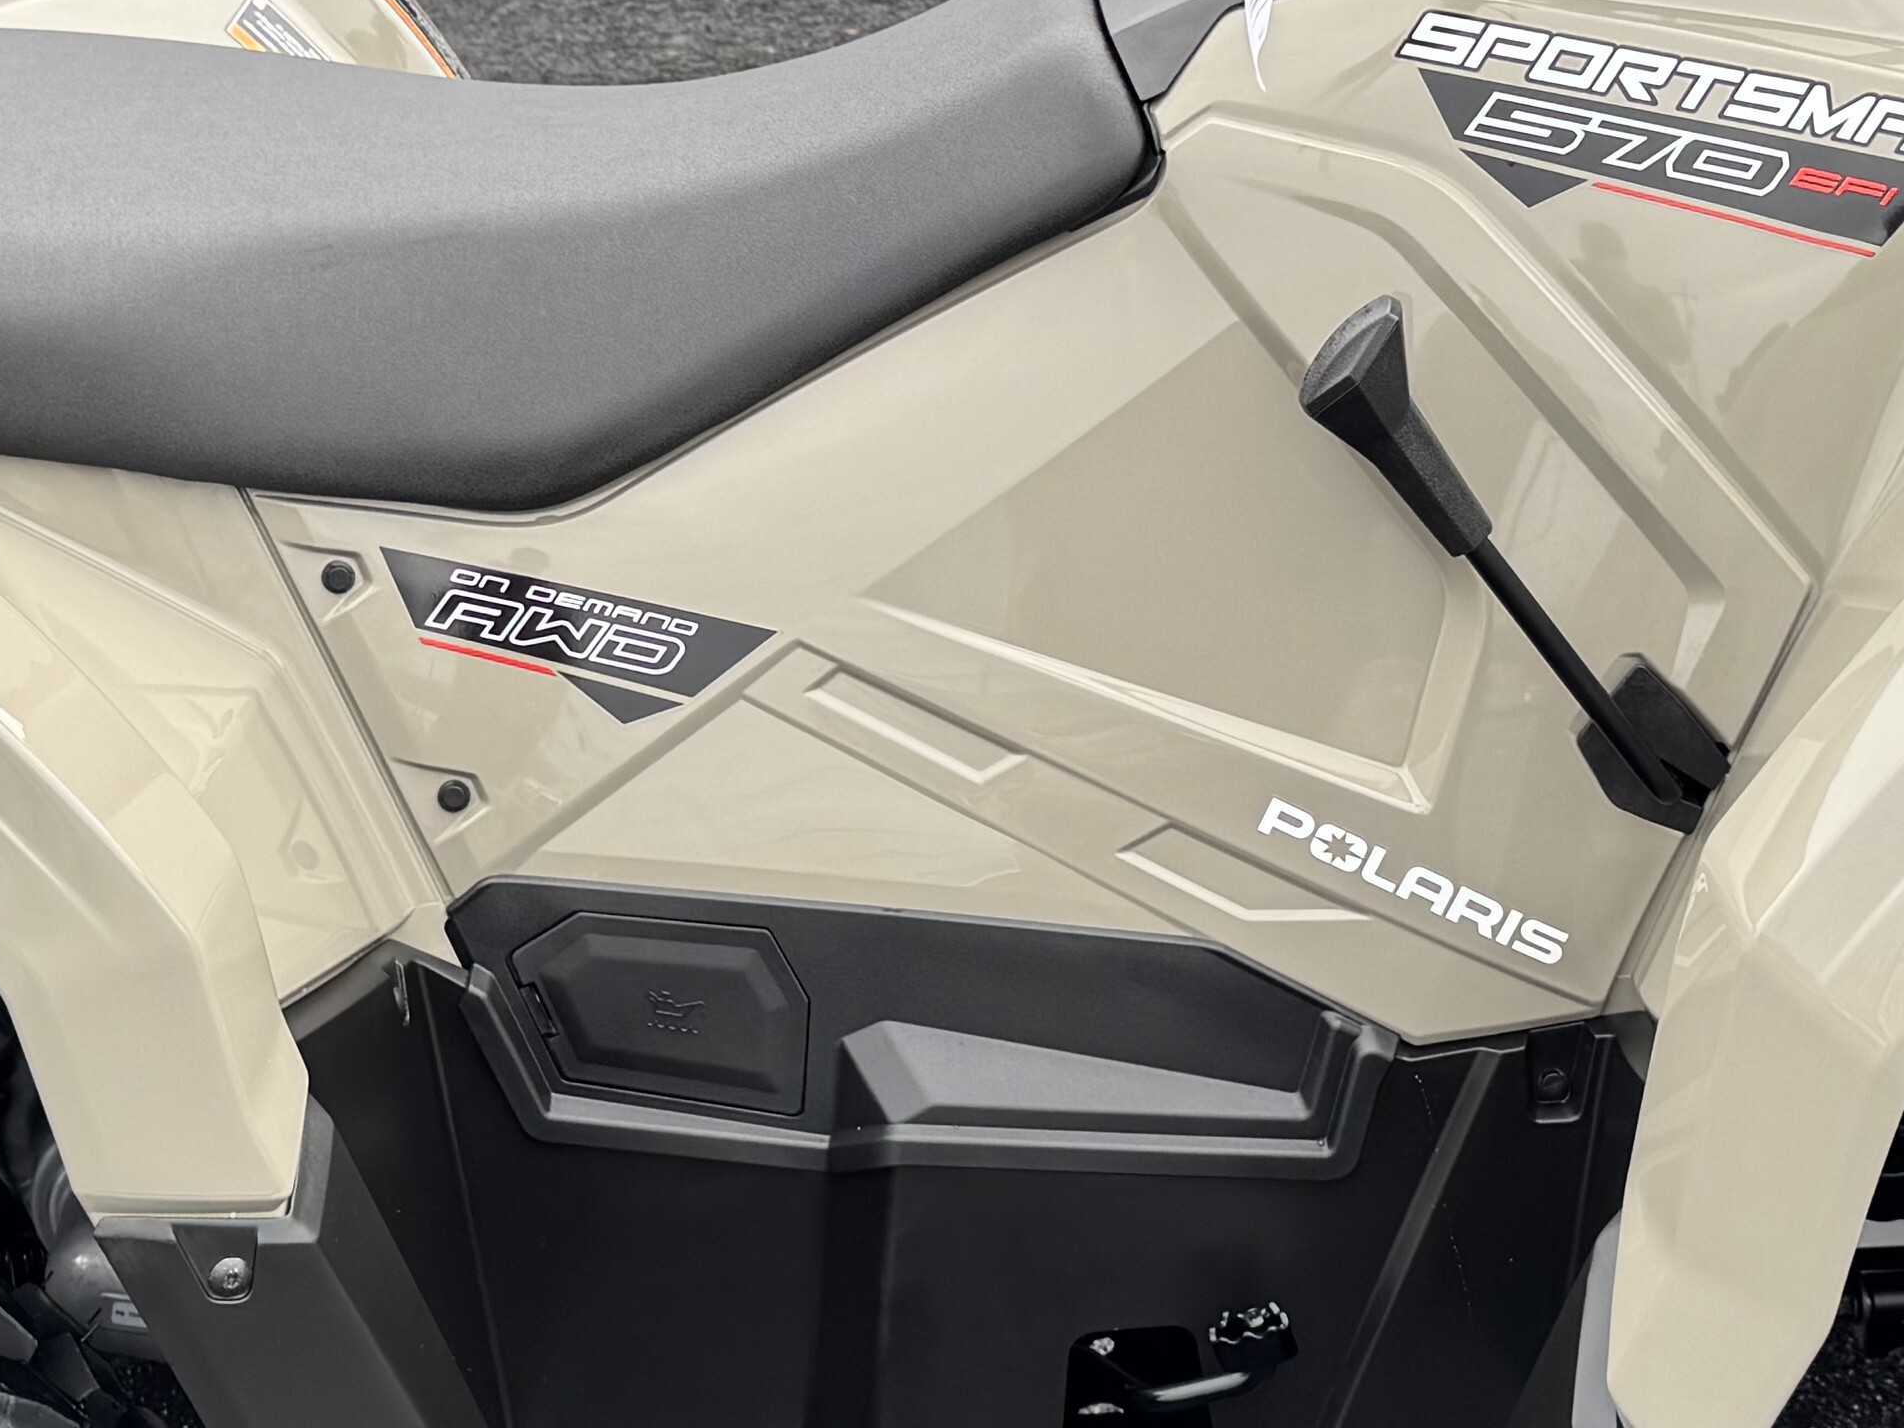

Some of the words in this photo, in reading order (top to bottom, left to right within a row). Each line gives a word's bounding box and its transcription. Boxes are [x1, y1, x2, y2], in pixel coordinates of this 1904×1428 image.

[1464, 91, 1793, 197] 570
[425, 589, 686, 676] AWD
[450, 568, 510, 592] ON
[526, 584, 699, 636] DEMAND
[1256, 797, 1570, 966] POLARIS
